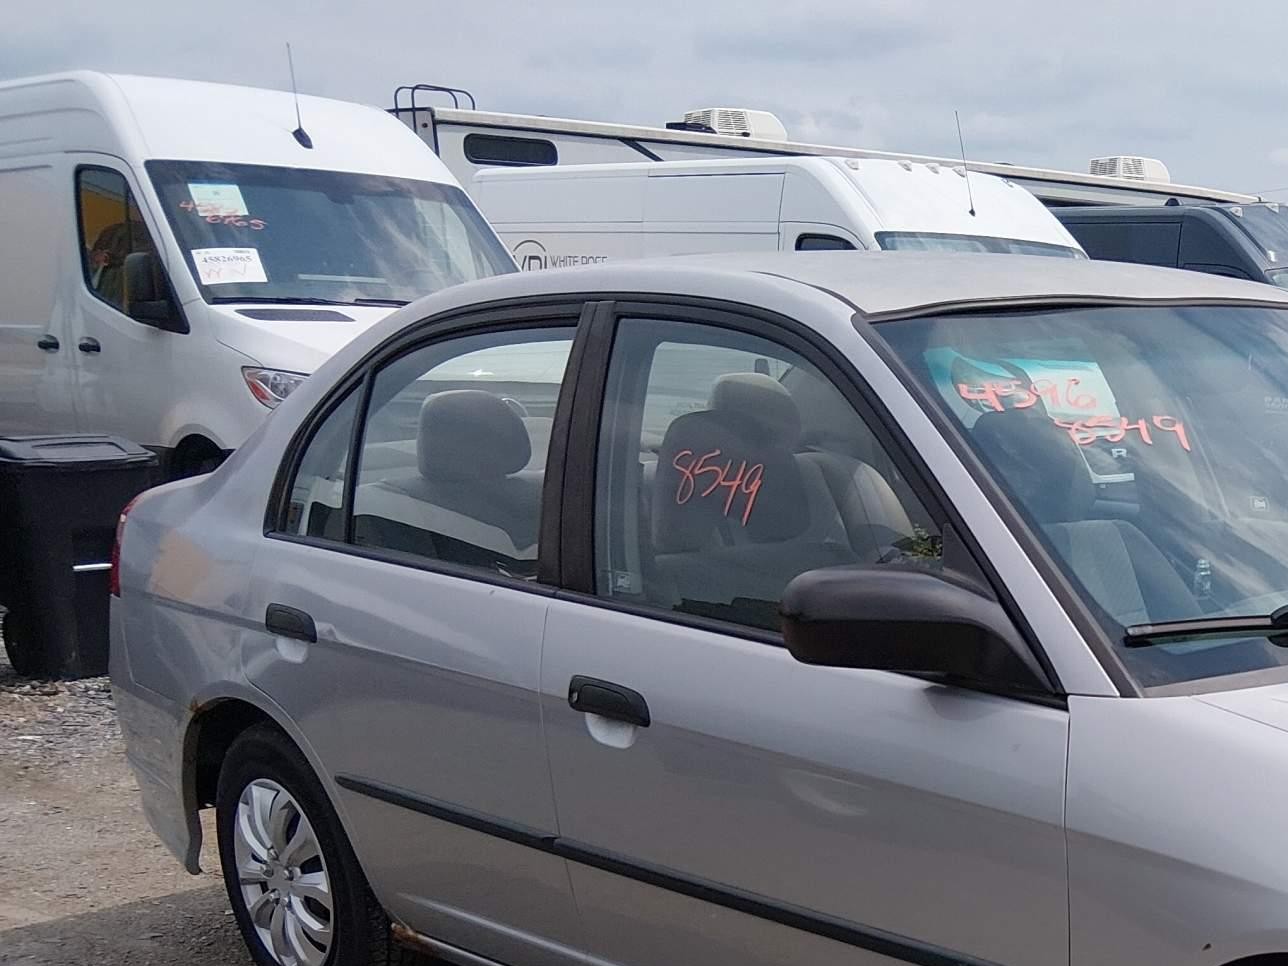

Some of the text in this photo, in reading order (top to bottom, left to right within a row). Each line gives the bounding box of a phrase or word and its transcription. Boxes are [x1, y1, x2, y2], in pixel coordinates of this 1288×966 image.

[550, 255, 580, 268] WHITE
[957, 378, 1098, 412] 4596
[672, 448, 765, 527] 8549
